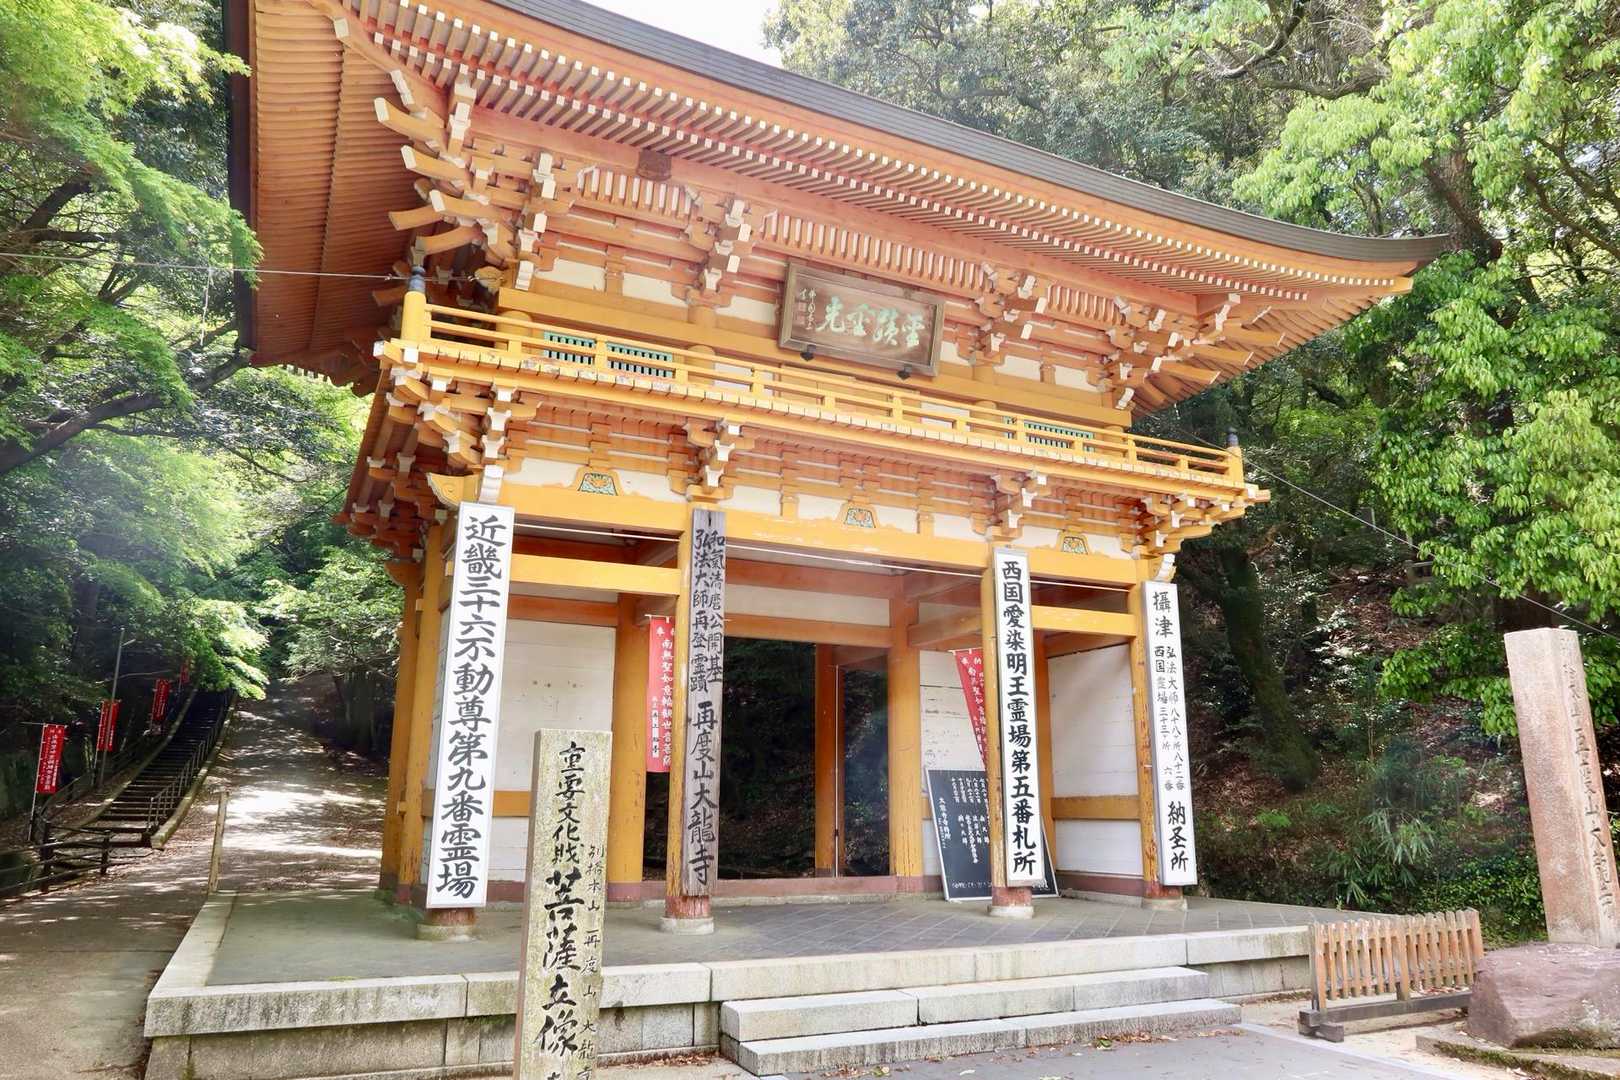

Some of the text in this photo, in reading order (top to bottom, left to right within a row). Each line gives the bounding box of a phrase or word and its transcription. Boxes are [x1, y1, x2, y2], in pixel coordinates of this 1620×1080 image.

[435, 514, 507, 899] 近畿三十六不動尊第九番霊場
[687, 700, 719, 886] 再度山大龍寺
[1001, 560, 1037, 876] 西国愛染明王霊場第五番札所
